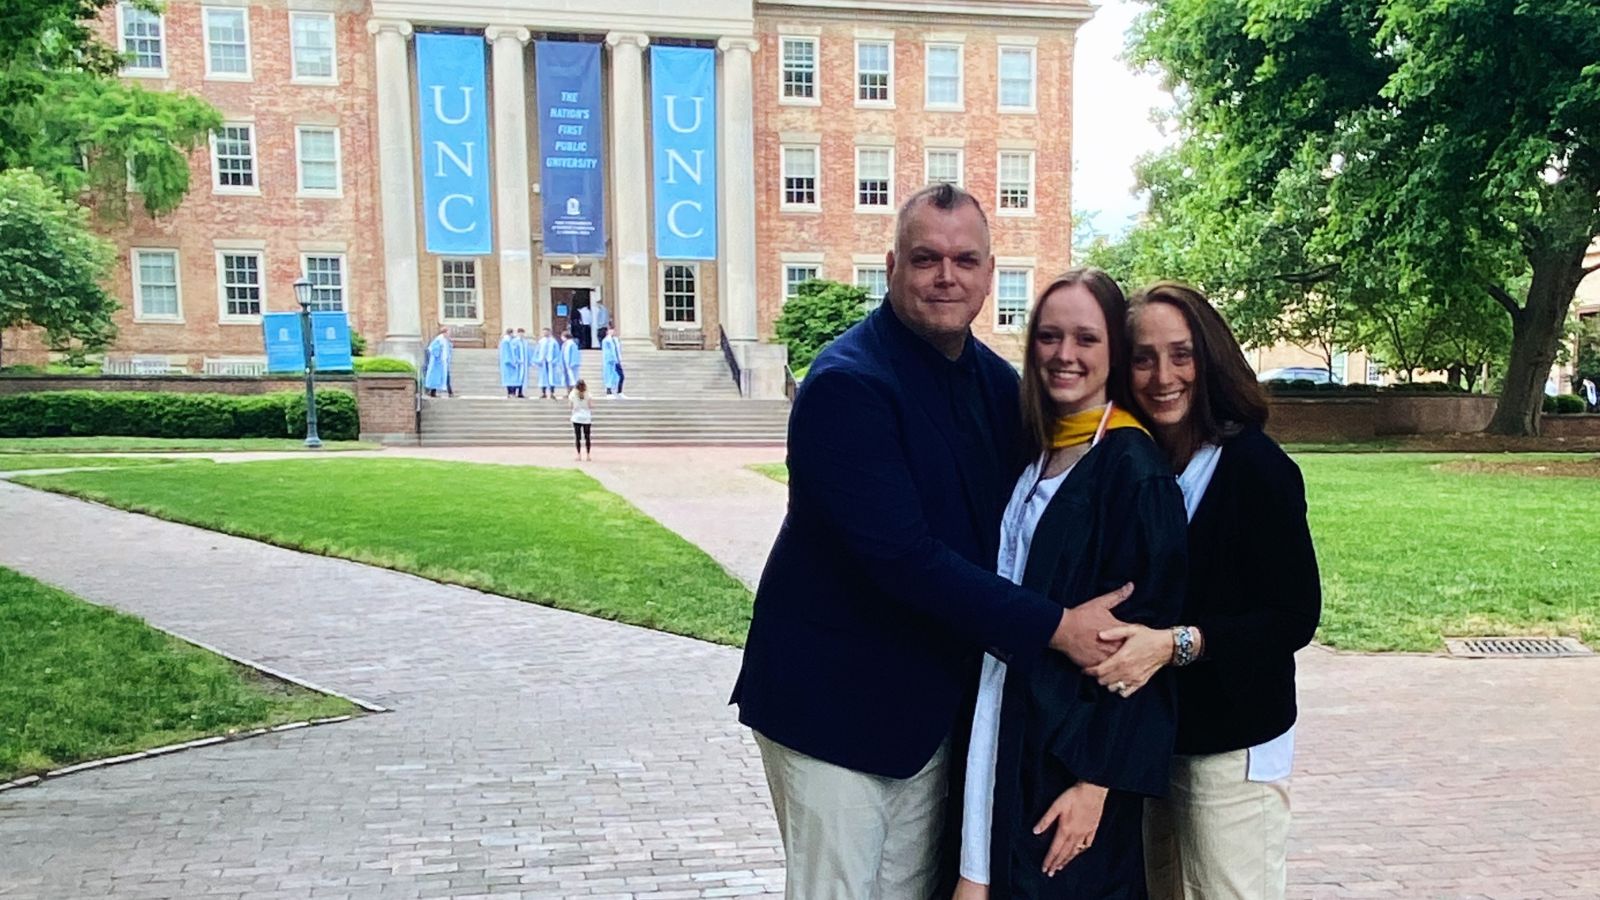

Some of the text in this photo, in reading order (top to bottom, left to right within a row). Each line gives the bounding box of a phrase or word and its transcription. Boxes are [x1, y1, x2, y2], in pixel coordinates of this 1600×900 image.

[561, 91, 578, 102] THE
[550, 108, 590, 119] NATION'S
[558, 124, 583, 135] FIRST
[555, 141, 587, 152] PUBLIC
[430, 85, 476, 233] UNC
[546, 157, 597, 168] UNIVERSITY
[663, 95, 704, 239] UNC
